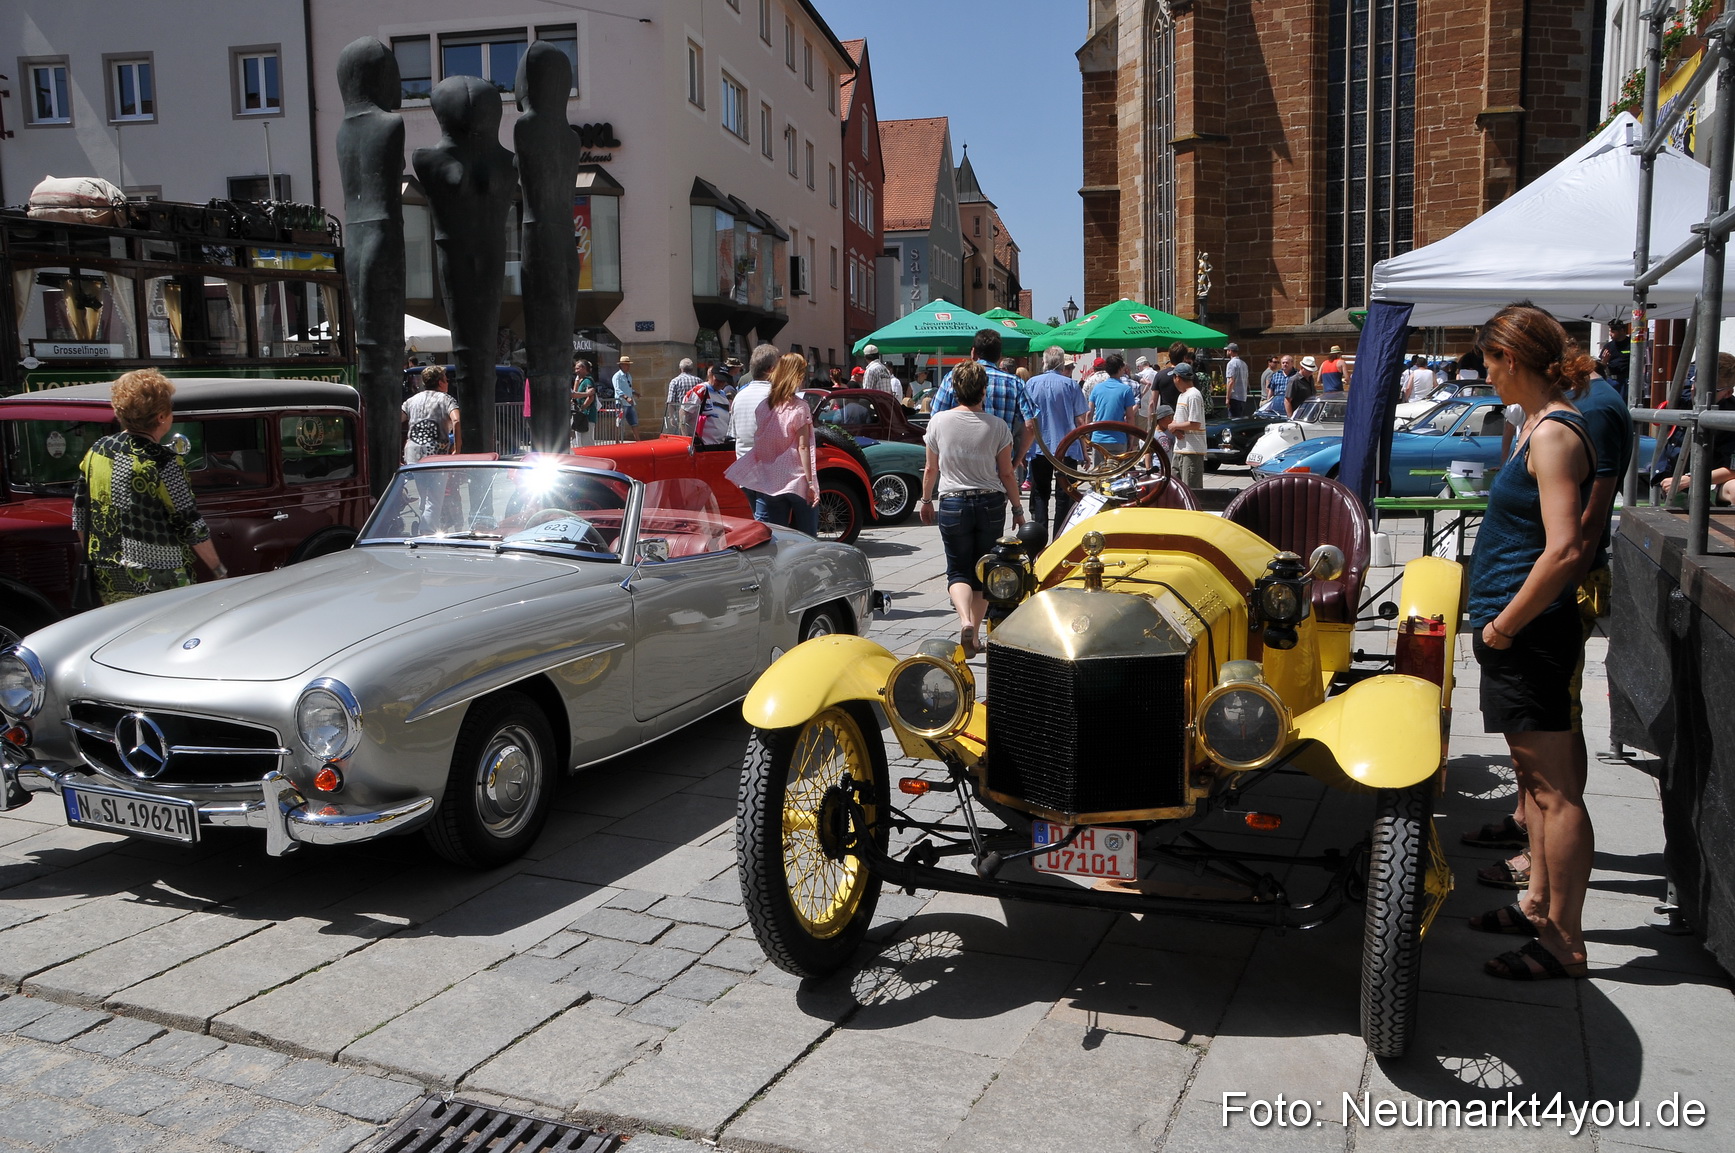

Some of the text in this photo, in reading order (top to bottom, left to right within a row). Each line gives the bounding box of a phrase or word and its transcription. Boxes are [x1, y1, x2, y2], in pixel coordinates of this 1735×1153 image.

[53, 345, 109, 357] Grosselfingen
[77, 794, 91, 820] N
[101, 798, 126, 825] SL
[127, 802, 190, 835] 1962H
[1047, 849, 1120, 876] 07101
